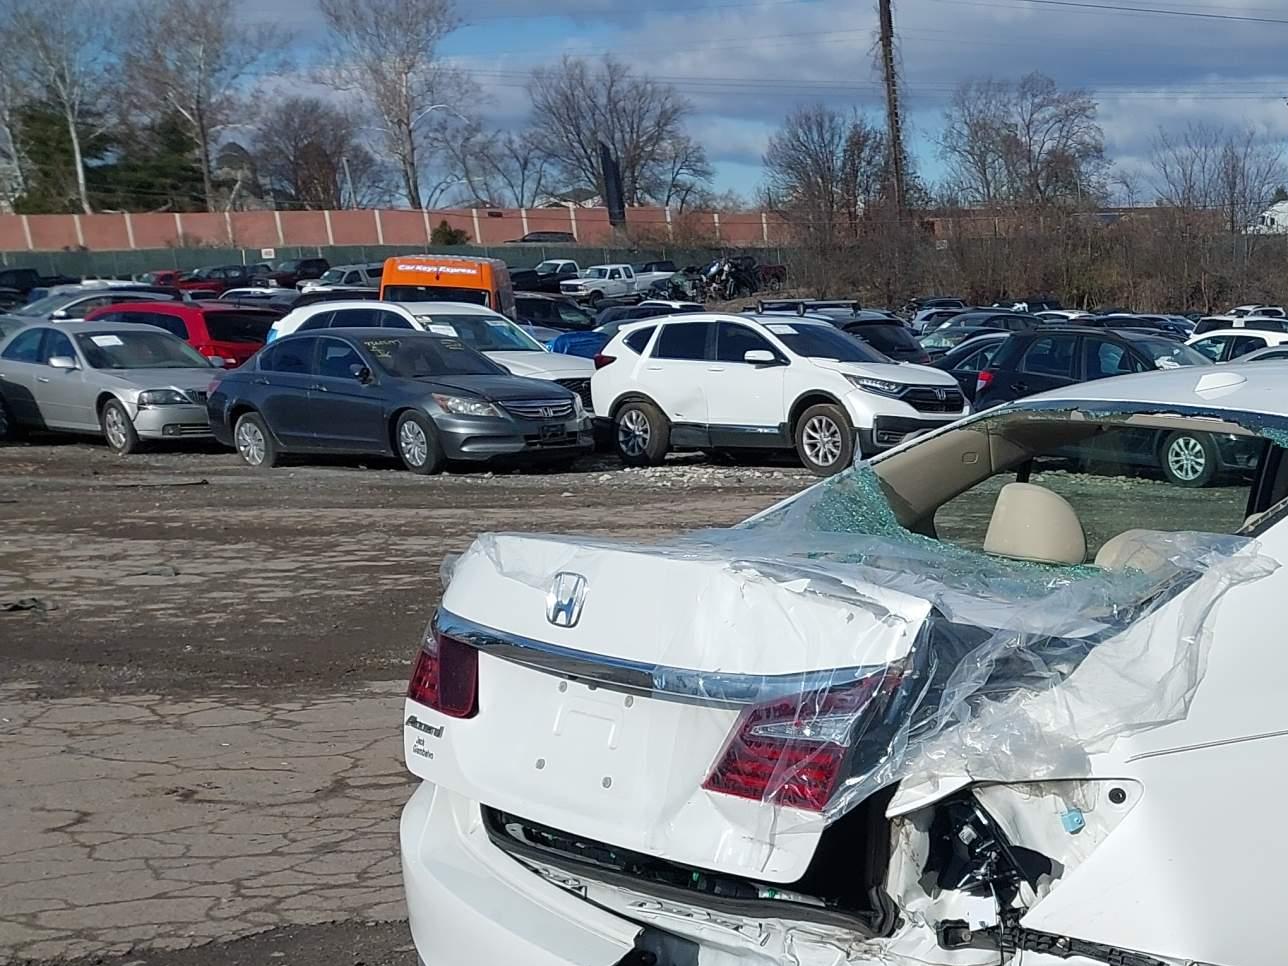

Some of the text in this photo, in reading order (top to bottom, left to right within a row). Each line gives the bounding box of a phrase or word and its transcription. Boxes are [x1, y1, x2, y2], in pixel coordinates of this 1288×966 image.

[398, 264, 477, 274] Car Keys Express
[405, 715, 445, 739] Accord
